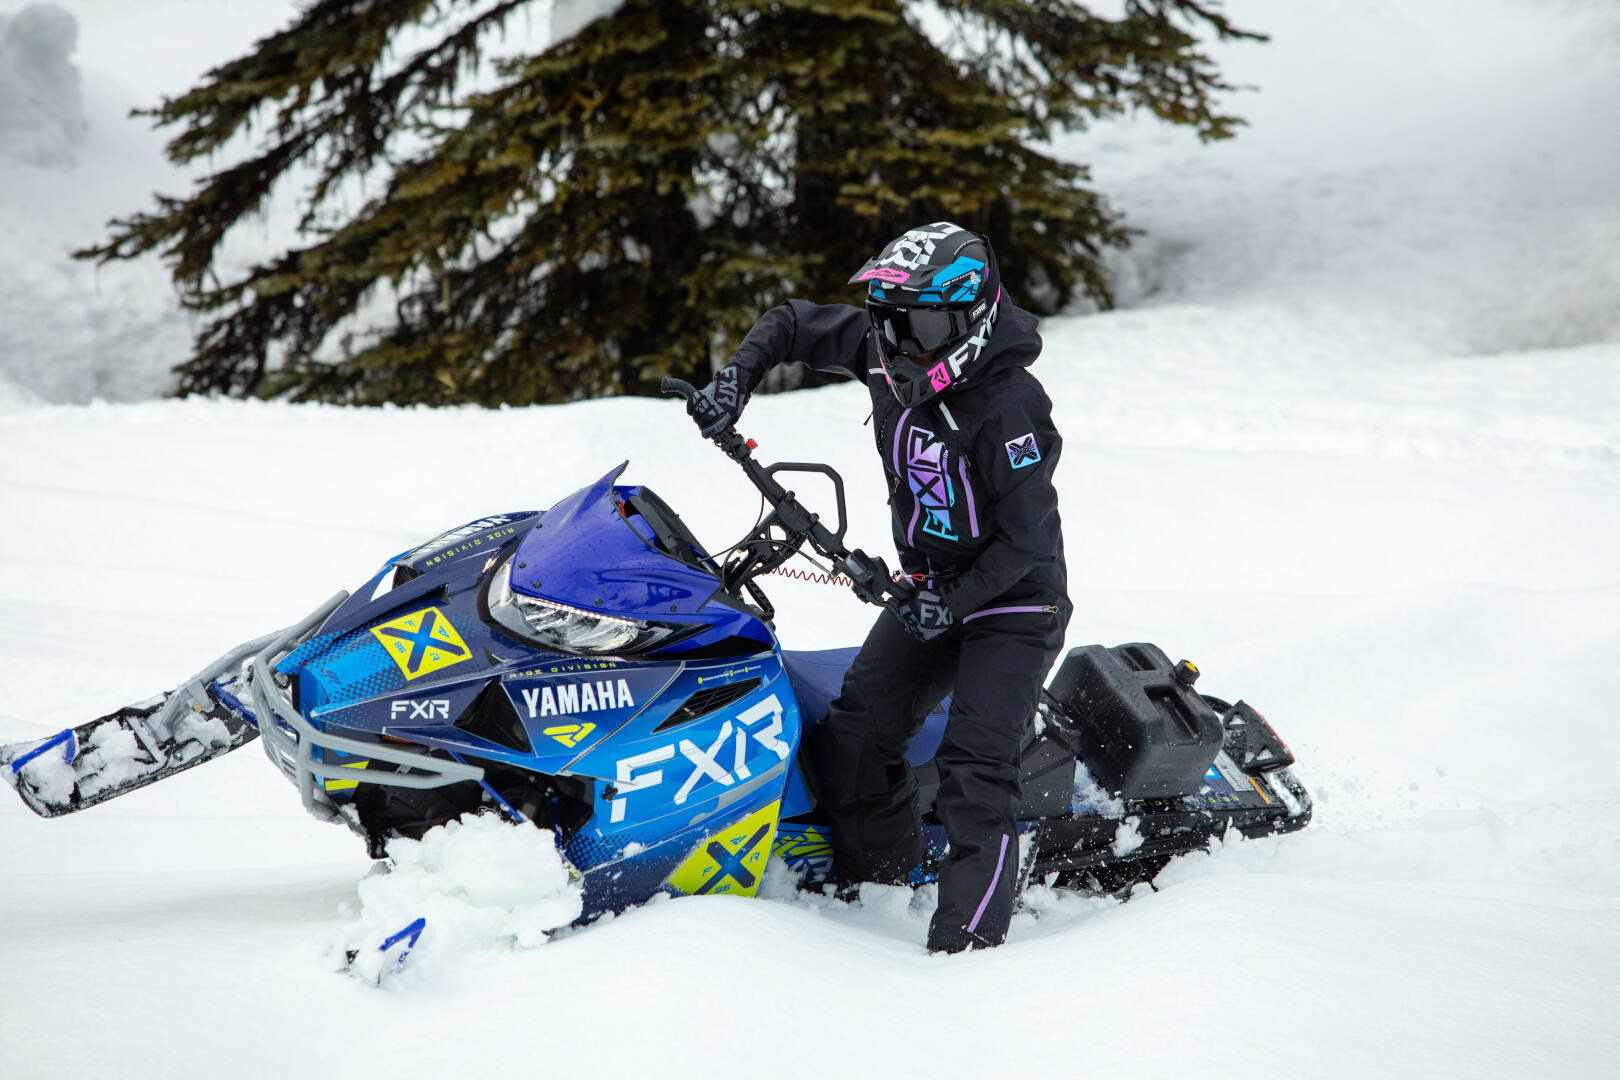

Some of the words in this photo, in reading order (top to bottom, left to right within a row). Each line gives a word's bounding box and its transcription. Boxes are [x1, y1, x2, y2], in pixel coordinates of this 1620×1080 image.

[551, 662, 617, 673] DIVISION
[390, 700, 450, 720] FXR
[521, 679, 634, 718] YAMAHA
[610, 693, 790, 823] FXR
